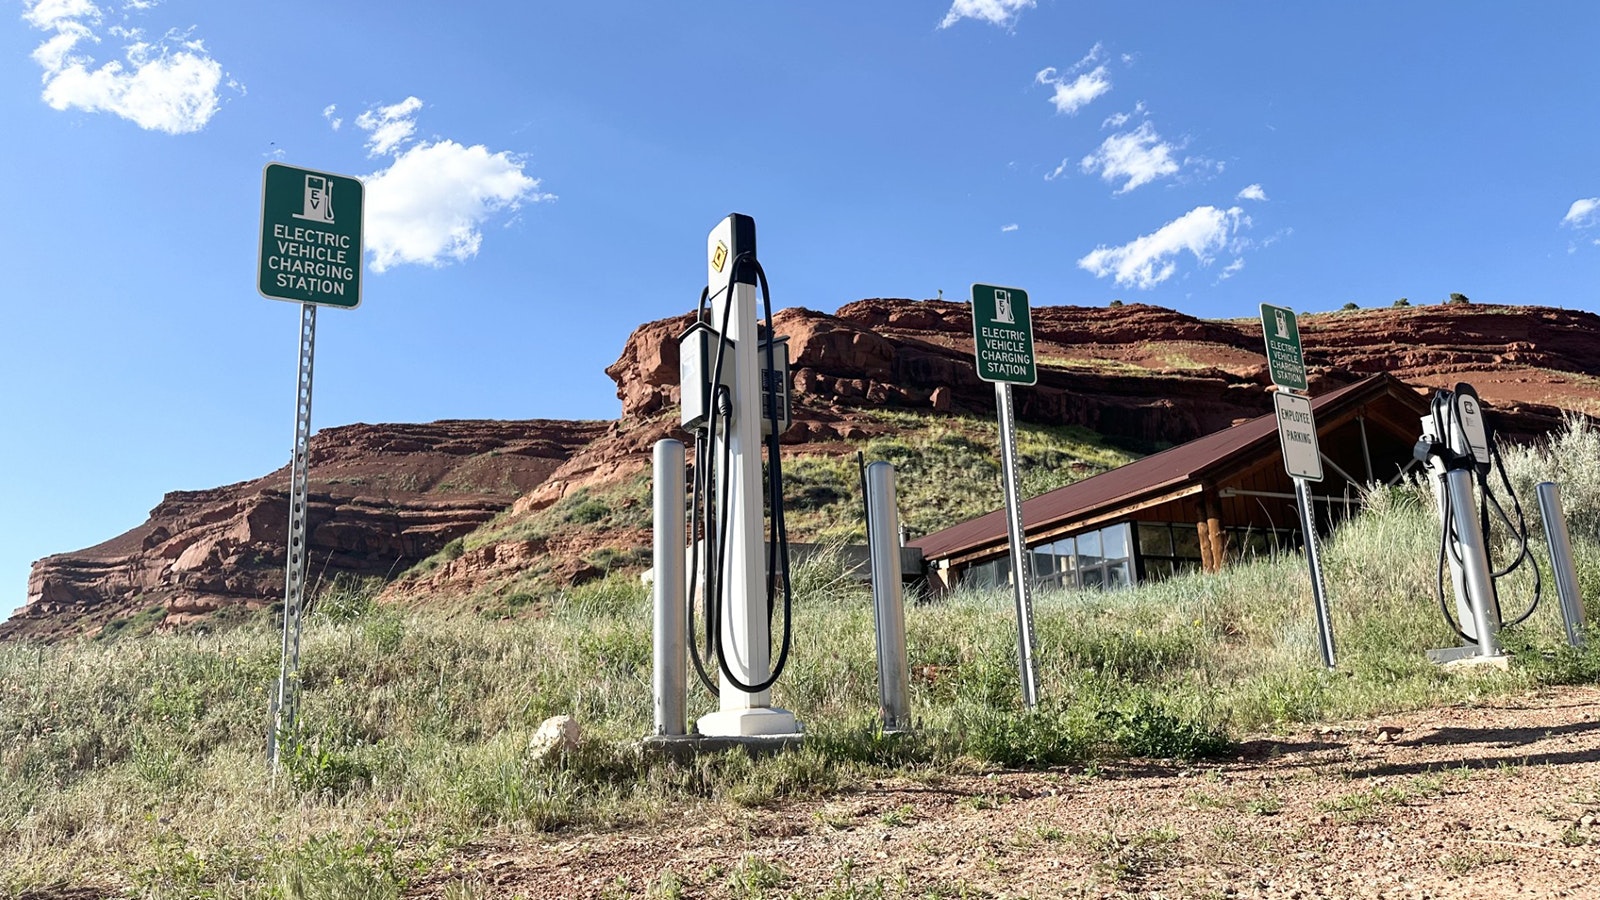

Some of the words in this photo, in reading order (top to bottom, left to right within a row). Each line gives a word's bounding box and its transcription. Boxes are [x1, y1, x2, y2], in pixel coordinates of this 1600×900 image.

[274, 224, 350, 249] ELECTRIC
[277, 240, 346, 264] VEHICLE
[268, 256, 353, 280] CHARGING
[277, 273, 344, 295] STATION
[981, 327, 1025, 341] ELECTRIC
[985, 339, 1025, 352] VEHICLE
[1270, 340, 1298, 354] ELECTRIC
[981, 350, 1030, 364] CHARGING
[1273, 350, 1298, 364] VEHICLE
[987, 362, 1026, 375] STATION
[1272, 360, 1302, 374] CHARGING
[1277, 370, 1301, 383] STATION
[1281, 408, 1310, 424] EMPLOYEE
[1286, 429, 1312, 444] PARKING
